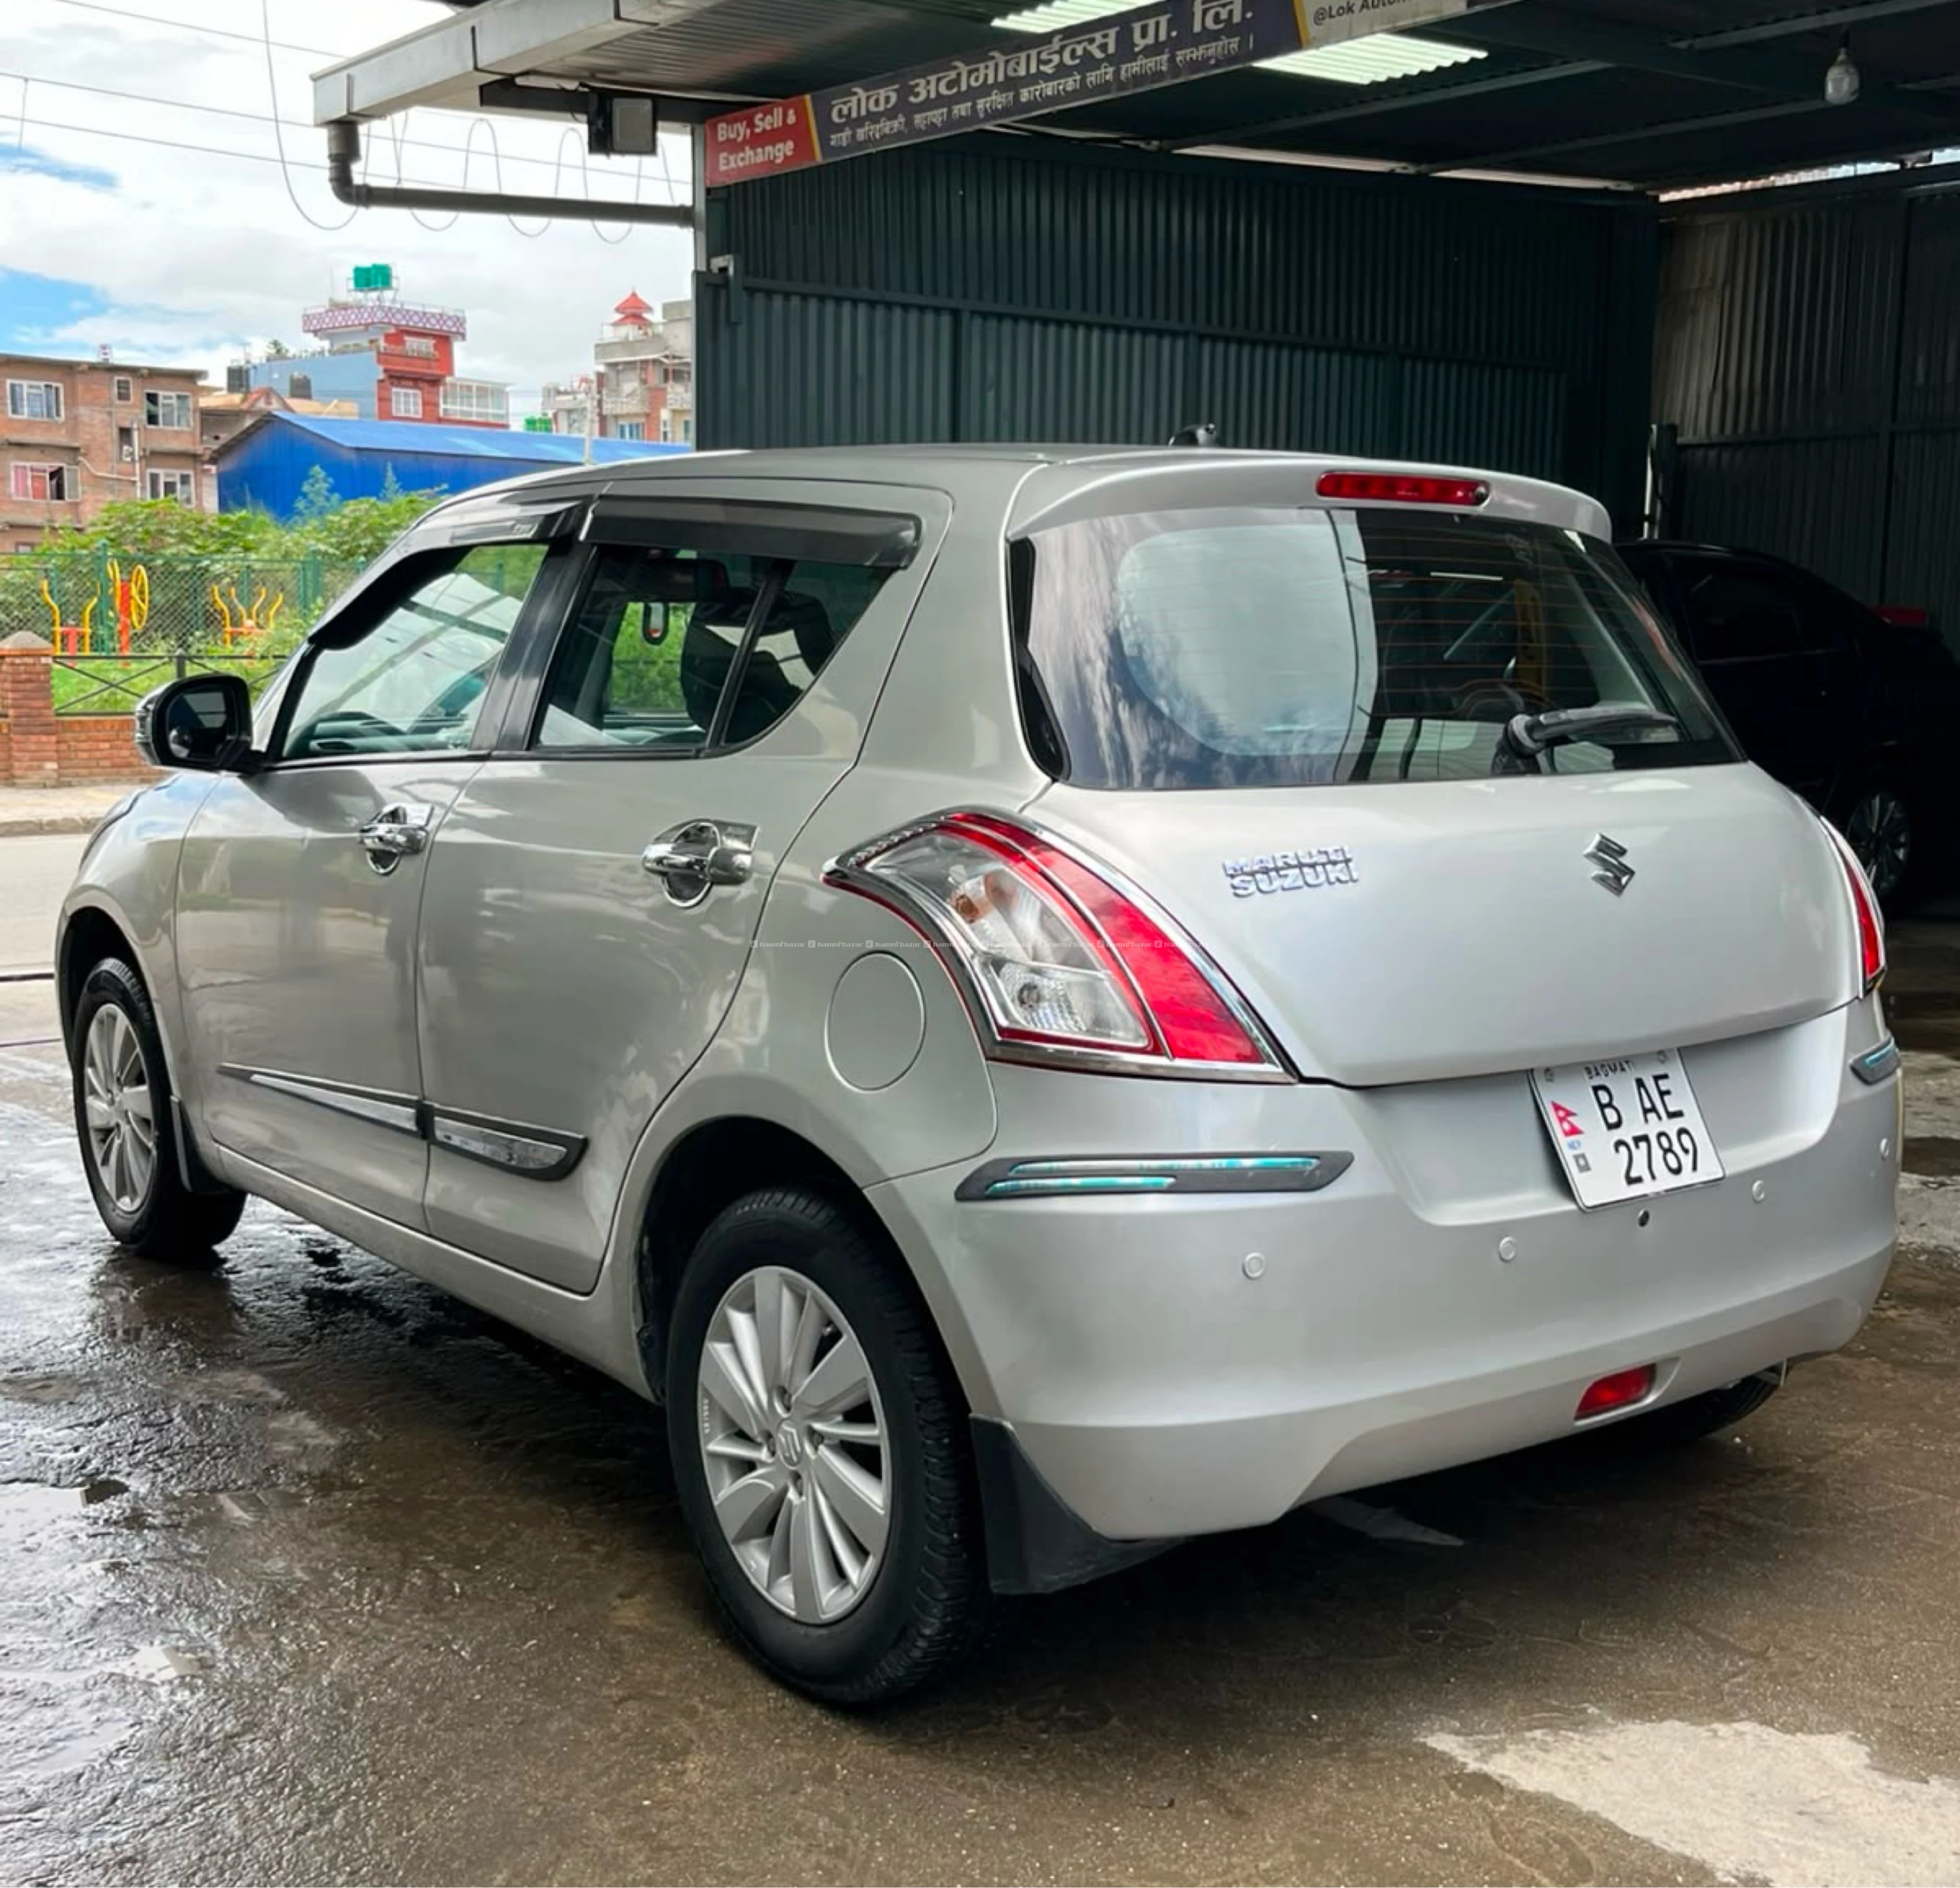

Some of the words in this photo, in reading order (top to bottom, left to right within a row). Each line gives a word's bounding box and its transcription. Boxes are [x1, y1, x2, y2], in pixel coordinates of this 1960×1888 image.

[1313, 1, 1355, 26] @Lok
[1359, 0, 1406, 13] Auto
[830, 84, 900, 123] लोक
[908, 27, 1120, 103] अटोमोबाईल्स
[1131, 14, 1178, 52] प्रा.
[1192, 0, 1253, 33] लि.
[1019, 71, 1082, 103] कारोबारको
[1086, 62, 1116, 89] लागि
[717, 120, 751, 142] Buy,
[753, 107, 783, 133] Sell
[786, 109, 796, 125] &
[718, 140, 794, 172] Exchange
[1223, 846, 1353, 878] MARUTI
[1230, 860, 1359, 898] SUZUKI
[1590, 1084, 1623, 1131] B
[1634, 1073, 1685, 1124] AE
[1613, 1126, 1698, 1186] 2789
